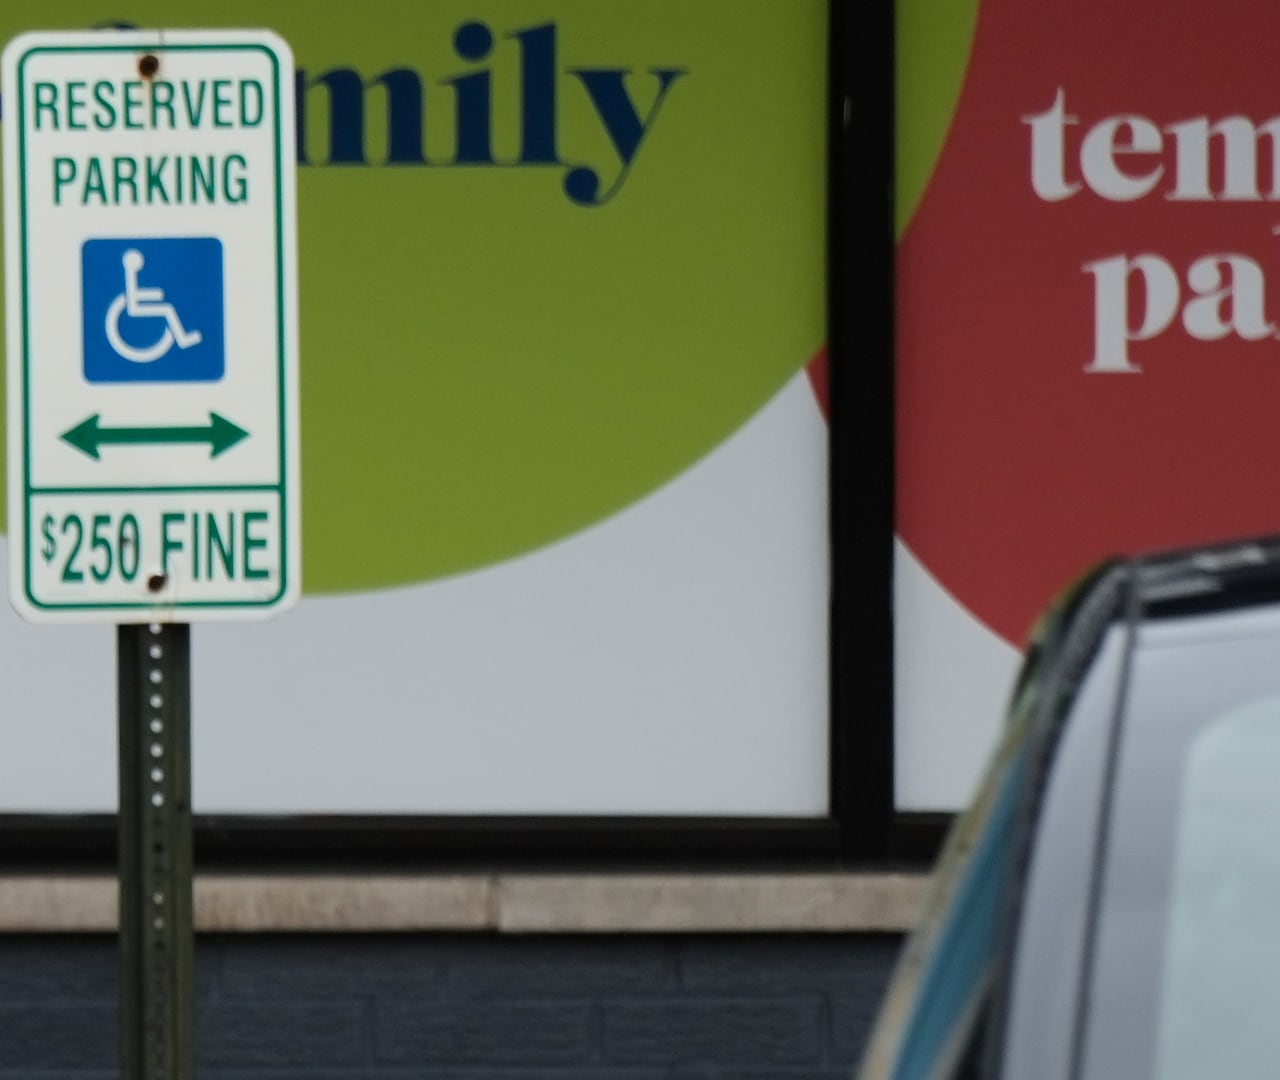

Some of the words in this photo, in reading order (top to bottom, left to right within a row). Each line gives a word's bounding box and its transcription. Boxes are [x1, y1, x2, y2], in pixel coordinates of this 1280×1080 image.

[32, 79, 266, 132] RESERVED
[294, 19, 689, 208] mily
[52, 154, 251, 207] PARKING
[1080, 226, 1280, 374] pa
[40, 511, 140, 584] $250
[161, 510, 270, 583] FINE
